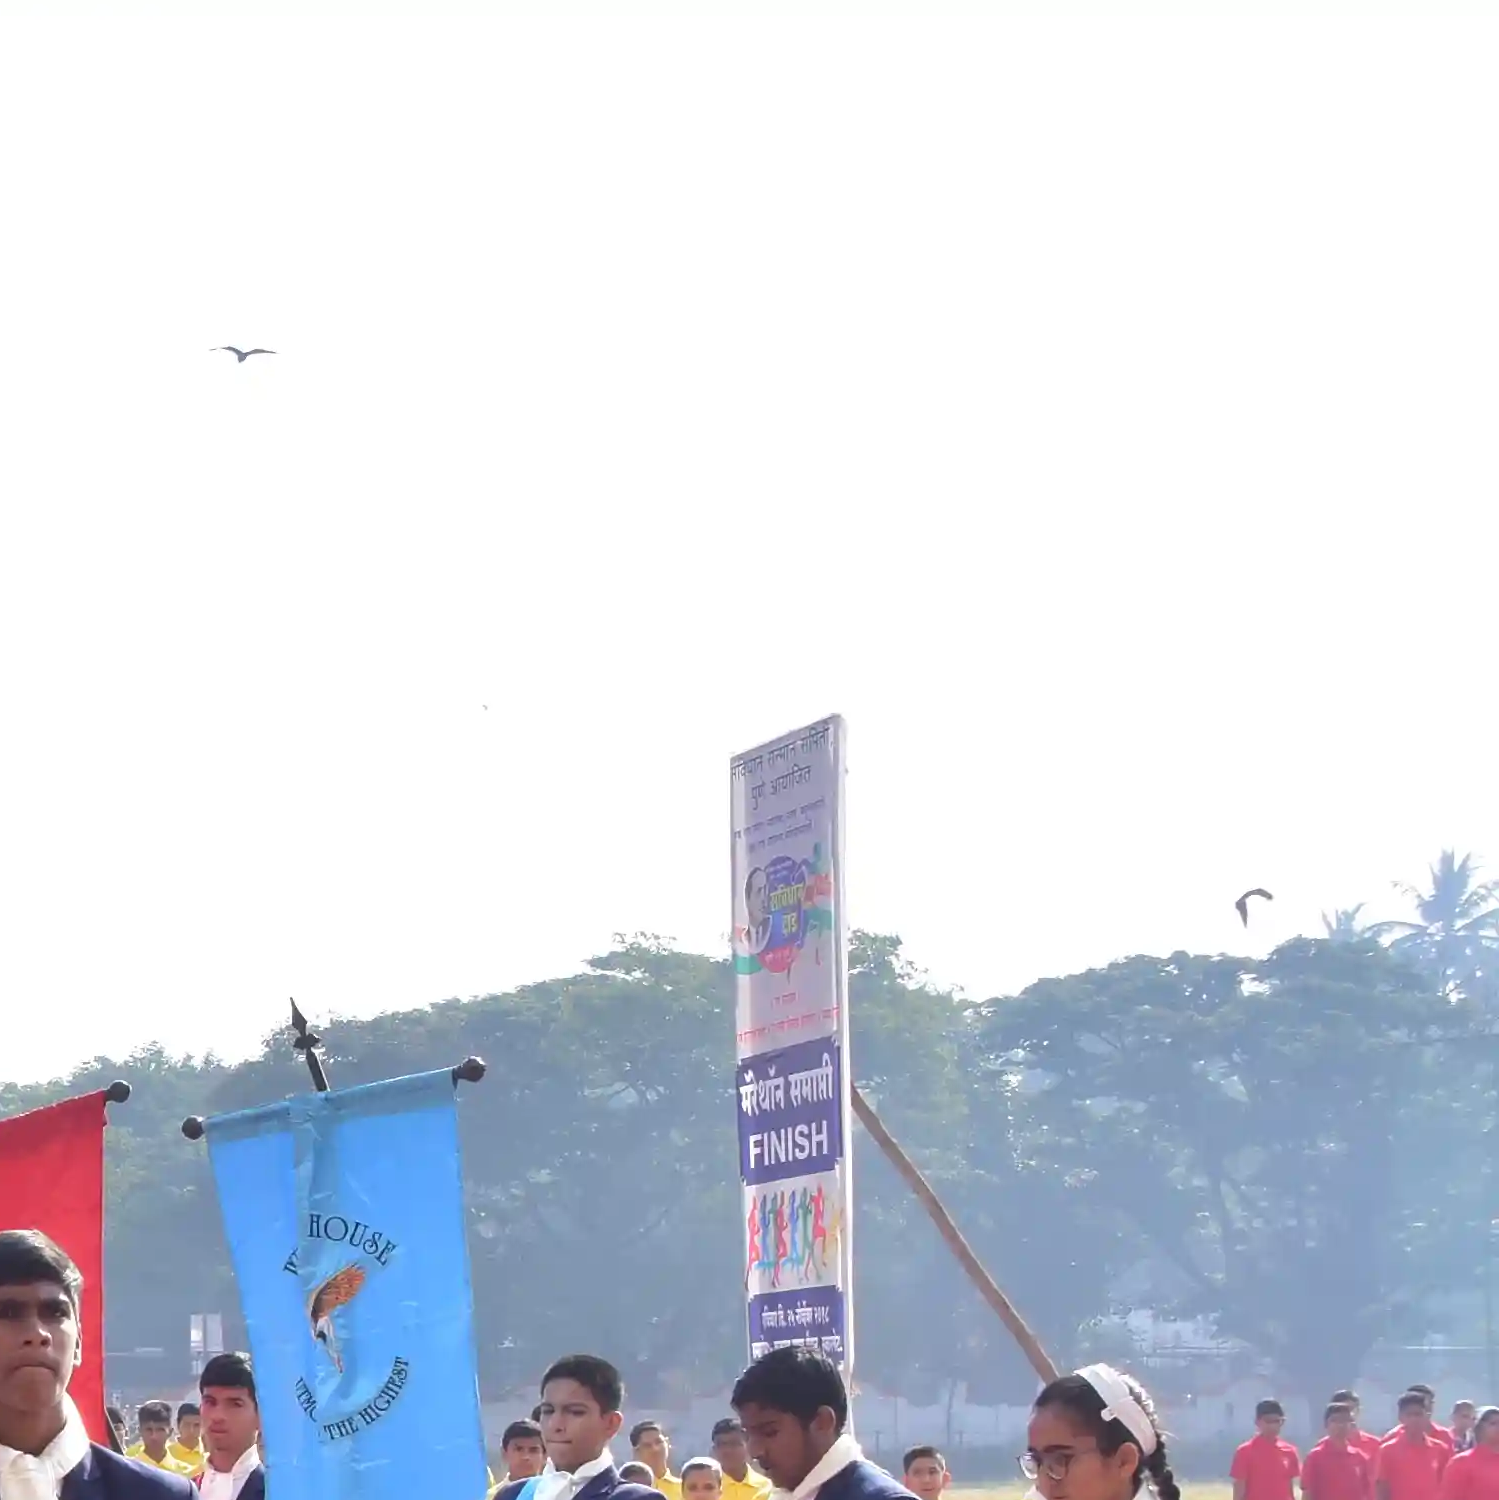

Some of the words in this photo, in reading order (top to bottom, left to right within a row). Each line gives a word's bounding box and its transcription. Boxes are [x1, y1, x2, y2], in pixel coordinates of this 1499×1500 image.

[749, 1120, 828, 1169] FINISH
[307, 1213, 397, 1266] HOUSE
[323, 1417, 359, 1441] THE
[360, 1356, 410, 1425] HIGHEST
